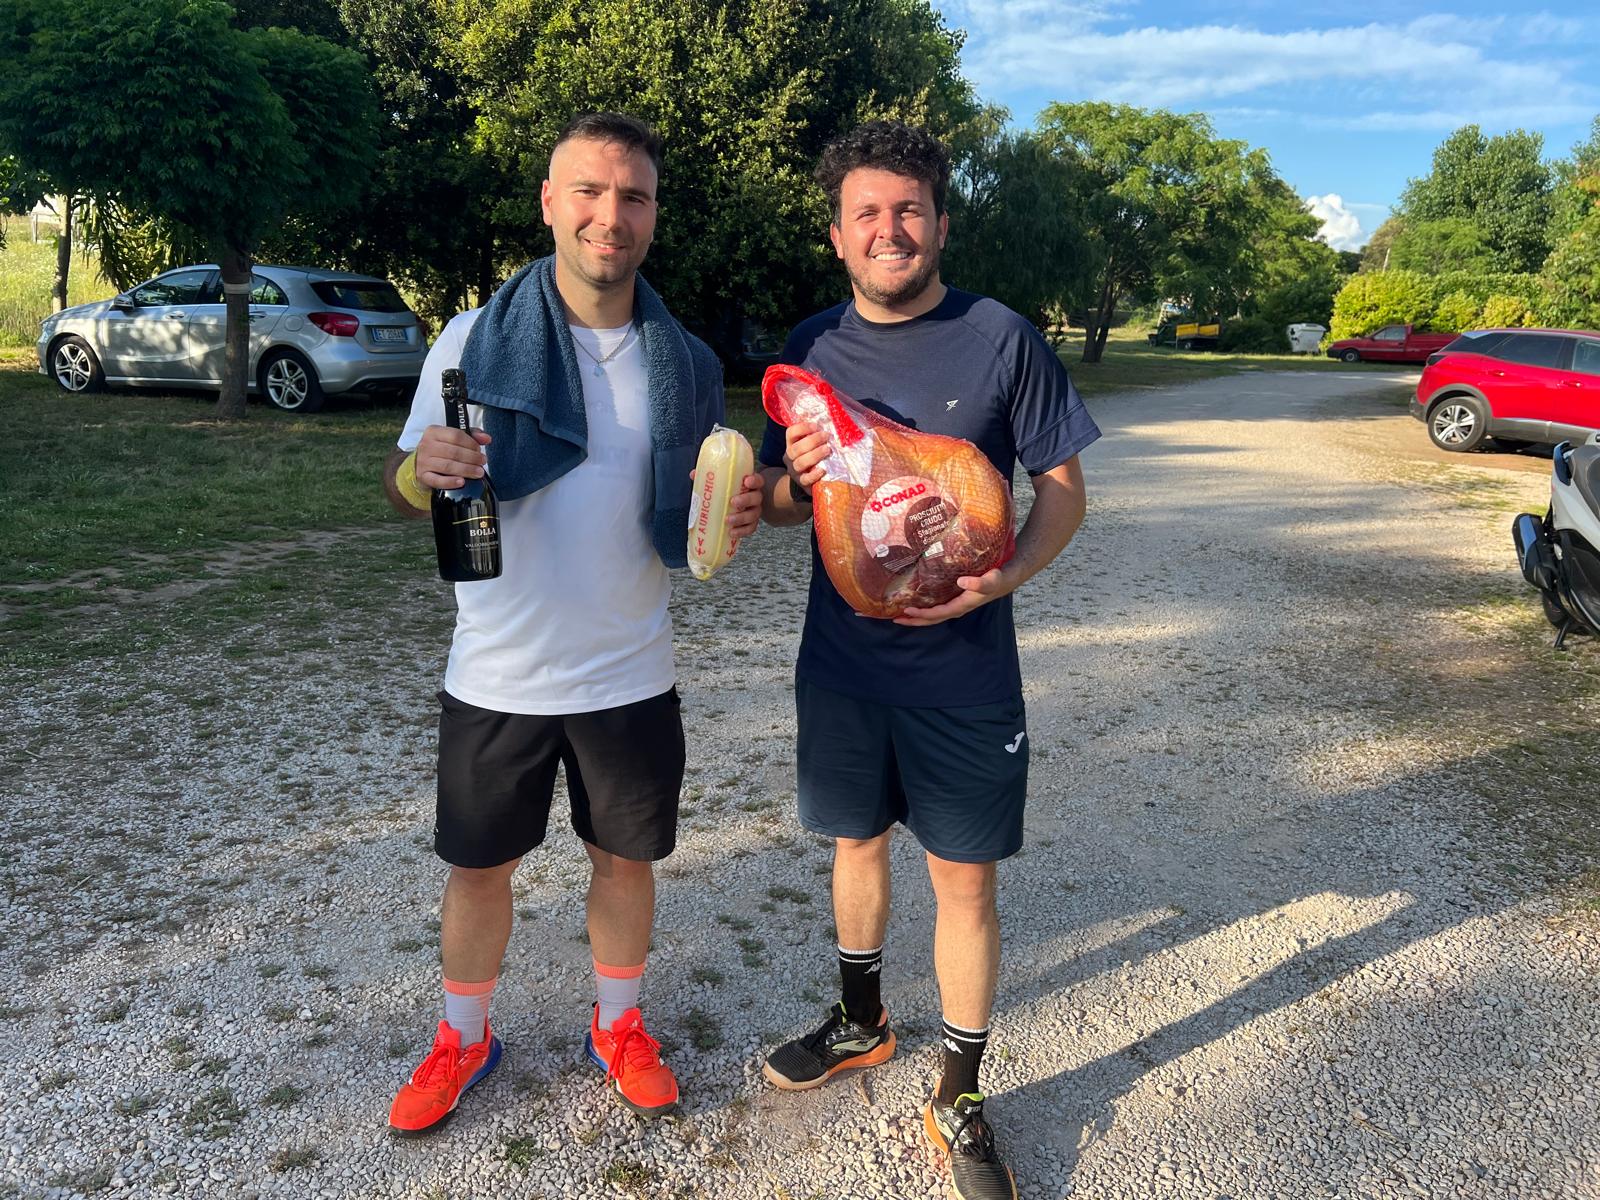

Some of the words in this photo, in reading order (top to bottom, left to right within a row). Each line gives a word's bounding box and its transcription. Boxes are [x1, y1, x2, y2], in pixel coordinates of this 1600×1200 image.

[457, 403, 467, 430] BOLLA
[699, 470, 716, 535] AURICCHIO
[882, 483, 927, 508] CONAD
[469, 527, 497, 537] BOLLA
[920, 513, 944, 528] CRUDO
